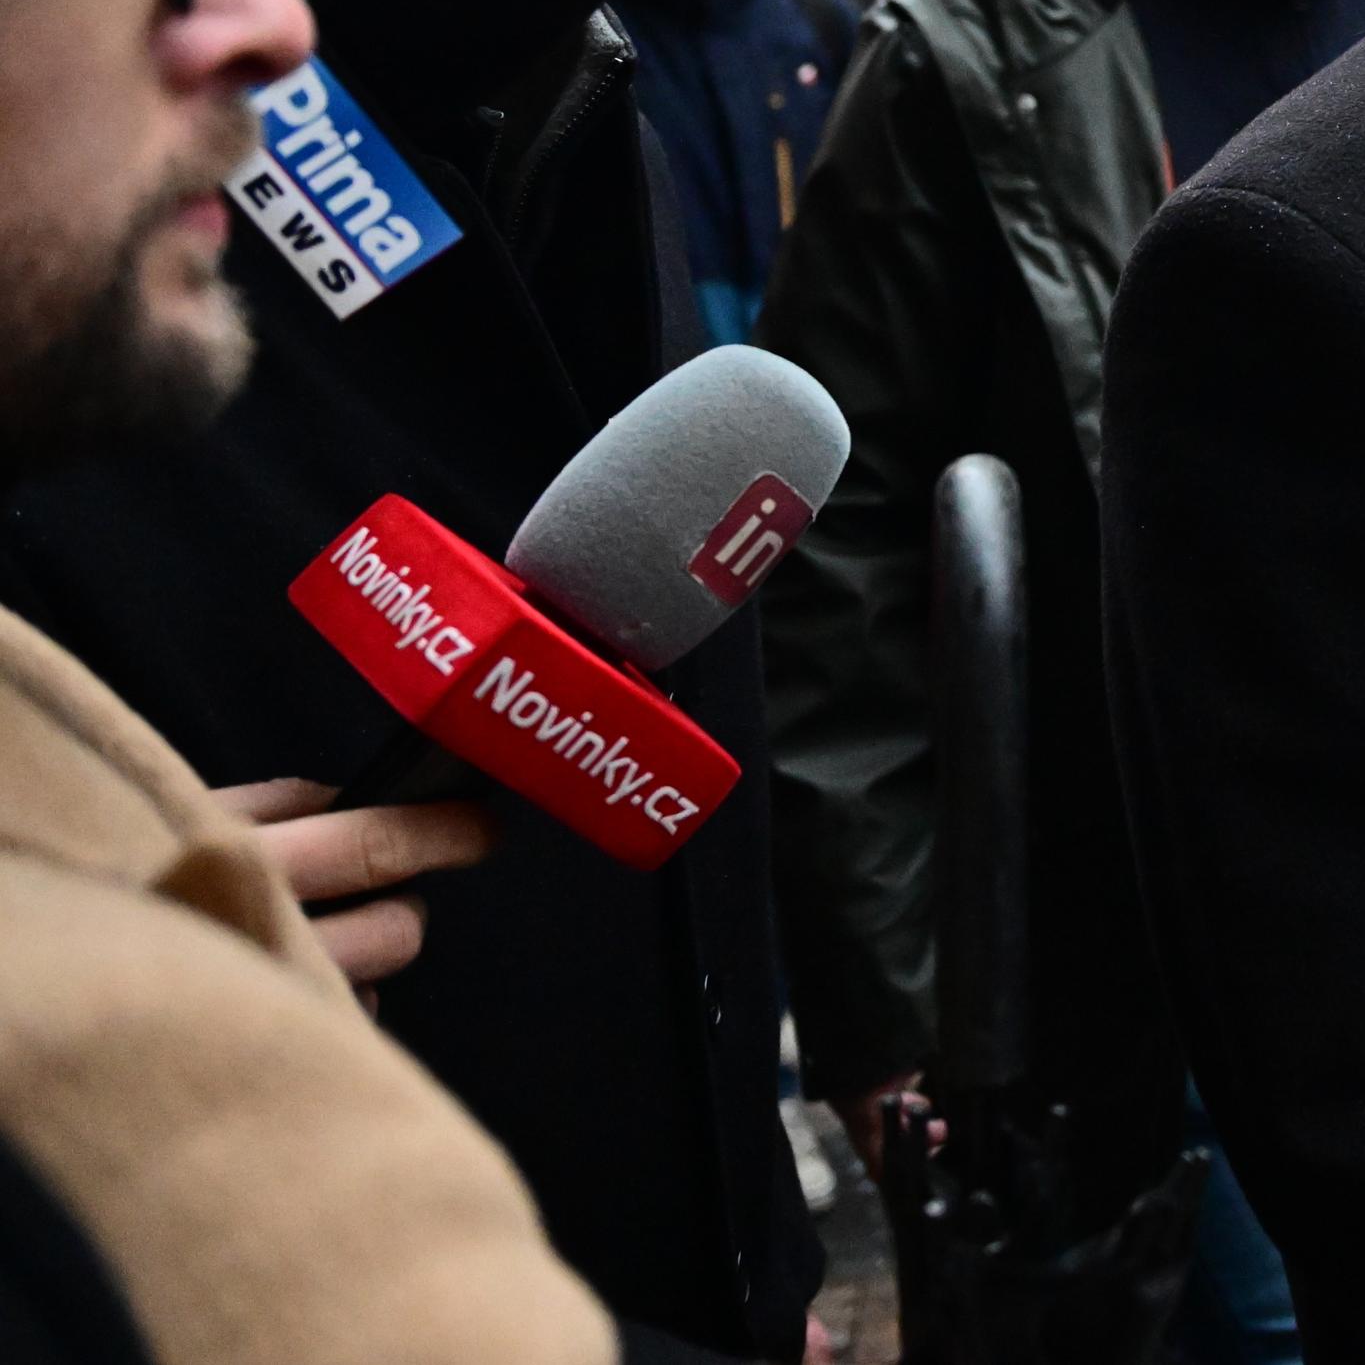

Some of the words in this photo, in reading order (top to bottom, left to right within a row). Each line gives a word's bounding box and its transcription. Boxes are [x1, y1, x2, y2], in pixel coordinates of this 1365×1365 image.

[243, 173, 356, 293] EWS
[249, 62, 421, 274] Prima
[330, 527, 476, 677] Novinky.cz
[473, 656, 699, 835] Novinky.cz
